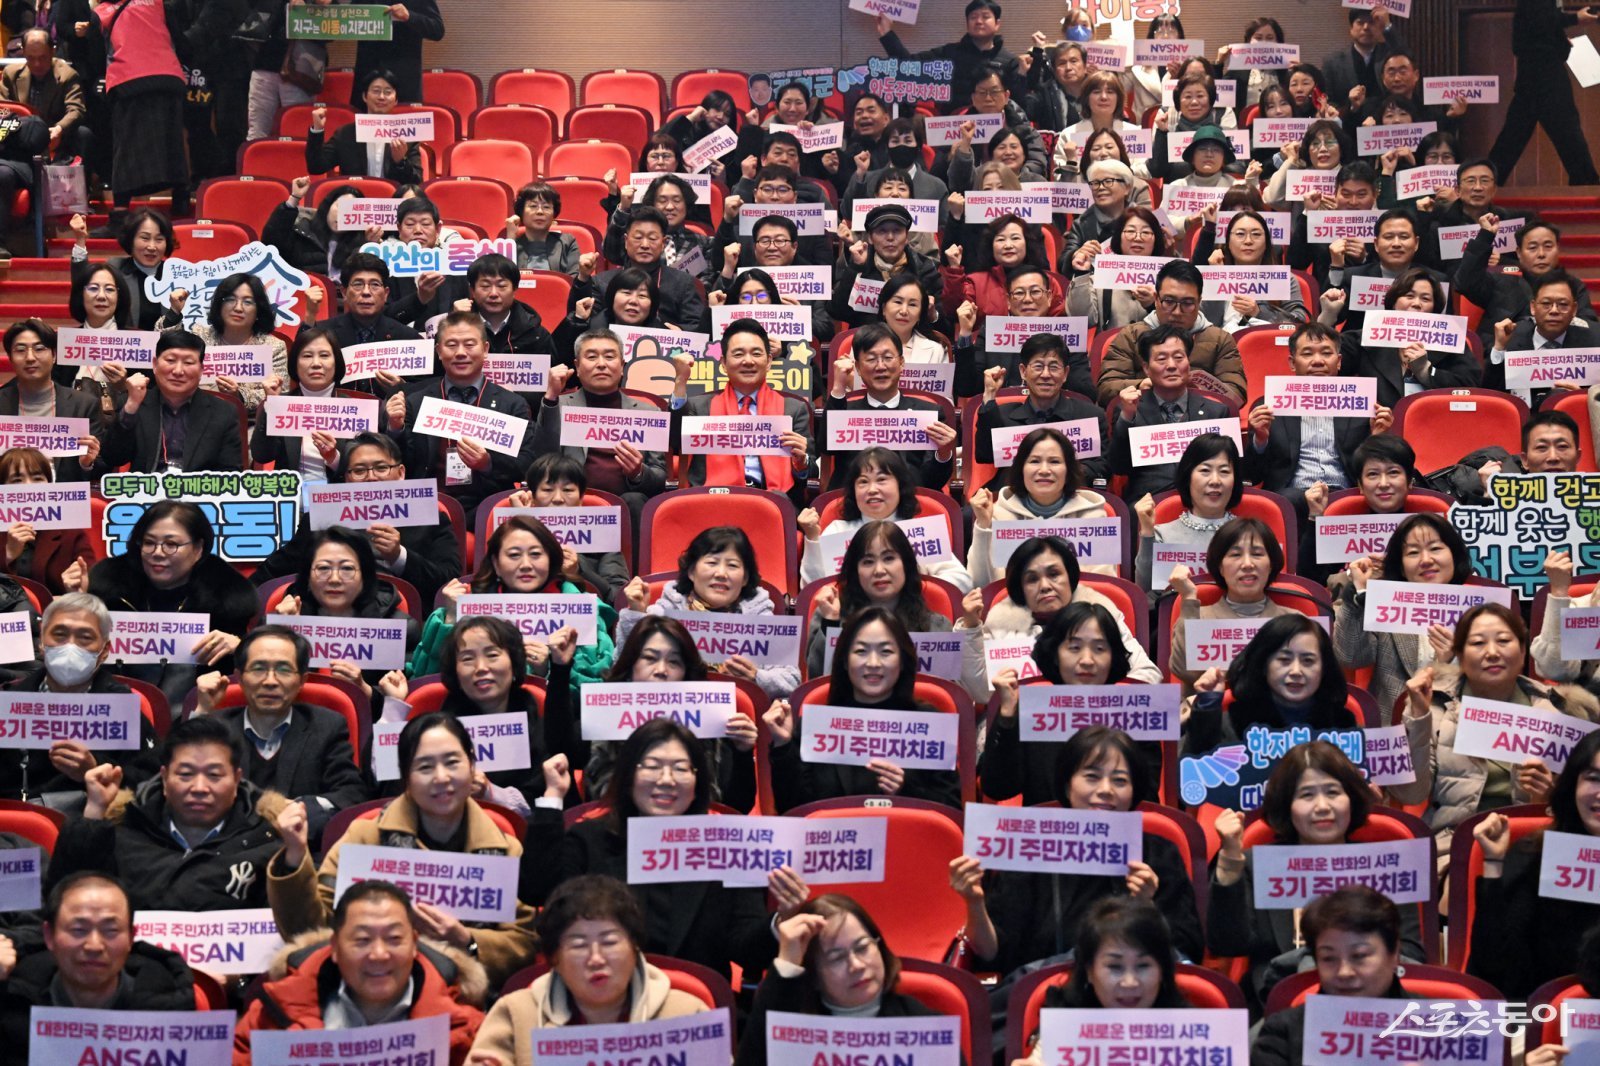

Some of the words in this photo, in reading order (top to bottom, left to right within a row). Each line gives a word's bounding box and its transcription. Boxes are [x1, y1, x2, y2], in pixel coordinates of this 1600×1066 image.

[294, 20, 319, 34] 지구는
[321, 20, 346, 34] 이동이
[348, 20, 384, 34] 지킨다!!
[1245, 56, 1283, 64] ANSAN
[869, 58, 896, 76] 한지붕
[900, 59, 920, 75] 아래
[923, 60, 953, 80] 따뜻한
[870, 78, 950, 102] 와동주민자치회
[374, 128, 416, 138] ANSAN
[1260, 133, 1276, 142] 3기
[1364, 140, 1380, 150] 3기
[1403, 183, 1420, 194] 3기
[344, 214, 360, 226] 3기
[1314, 226, 1332, 238] 3기
[171, 264, 199, 278] 젊음과
[203, 264, 221, 278] 쉼이
[222, 248, 261, 273] 함께하는
[800, 272, 814, 280] 시작
[1229, 272, 1258, 280] 주민자치
[1259, 272, 1288, 280] 국가대표
[1217, 283, 1268, 294] ANSAN
[779, 311, 794, 320] 시작
[1004, 323, 1027, 332] 새로운
[1029, 323, 1052, 332] 변화의
[1054, 323, 1070, 332] 시작
[994, 334, 1016, 346] 3기
[1395, 329, 1458, 346] 주민자치회
[64, 346, 86, 360] 3기
[237, 352, 254, 361] 시작
[376, 348, 399, 357] 변화의
[400, 346, 416, 356] 시작
[366, 356, 426, 372] 주민자치회
[1508, 357, 1540, 366] 대한민국
[1542, 356, 1574, 365] 주민자치
[1531, 367, 1586, 381] ANSAN
[1285, 384, 1311, 393] 새로운
[1312, 384, 1338, 394] 변화의
[1340, 384, 1356, 394] 시작
[1273, 395, 1296, 410] 3기
[1301, 395, 1368, 411] 주민자치회
[564, 414, 598, 424] 대한민국
[600, 415, 632, 426] 주민자치
[729, 422, 754, 432] 변화의
[756, 422, 772, 432] 시작
[874, 418, 899, 427] 변화의
[900, 418, 918, 427] 시작
[25, 424, 50, 433] 변화의
[52, 424, 70, 434] 시작
[586, 428, 644, 443] ANSAN
[1150, 431, 1176, 441] 새로운
[690, 434, 714, 448] 3기
[836, 430, 860, 444] 3기
[1140, 444, 1164, 459] 3기
[104, 474, 158, 496] 모두가
[164, 474, 238, 496] 함께해서
[243, 474, 298, 496] 행복한
[7, 492, 46, 502] 주민자치
[48, 490, 87, 502] 국가대표
[313, 492, 351, 504] 대한민국
[353, 490, 393, 501] 주민자치
[394, 487, 434, 498] 국가대표
[1492, 477, 1546, 510] 함께
[340, 503, 409, 522] ANSAN
[579, 514, 618, 526] 국가대표
[1453, 508, 1507, 541] 함께
[1516, 506, 1570, 543] 웃는
[907, 527, 925, 538] 시작
[996, 530, 1035, 540] 대한민국
[1079, 526, 1118, 538] 국가대표
[1320, 524, 1358, 536] 대한민국
[1156, 551, 1196, 562] 대한민국
[1393, 591, 1425, 603] 새로운
[461, 604, 503, 616] 대한민국
[506, 604, 548, 614] 주민자치
[551, 602, 593, 614] 국가대표
[1376, 606, 1406, 626] 3기
[116, 621, 159, 634] 주민자치
[162, 622, 205, 635] 국가대표
[316, 625, 358, 638] 주민자치
[360, 626, 402, 640] 국가대표
[713, 622, 755, 636] 주민자치
[758, 624, 798, 636] 국가대표
[1212, 628, 1243, 640] 새로운
[920, 641, 960, 653] 국가대표
[1197, 644, 1227, 662] 3기
[586, 693, 632, 706] 대한민국
[636, 692, 682, 706] 주민자치
[685, 692, 732, 705] 국가대표
[1049, 695, 1084, 708] 새로운
[1088, 694, 1124, 708] 변화의
[1126, 694, 1151, 708] 시작
[10, 702, 46, 715] 새로운
[48, 703, 83, 716] 변화의
[86, 703, 110, 717] 시작
[830, 718, 864, 732] 새로운
[866, 720, 902, 734] 변화의
[905, 722, 929, 736] 시작
[1032, 713, 1066, 732] 3기
[1464, 706, 1512, 728] 대한민국
[1515, 714, 1562, 737] 주민자치
[31, 720, 128, 741] 주민자치회
[478, 722, 524, 738] 국가대표
[812, 733, 845, 755] 3기
[849, 734, 945, 760] 주민자치회
[996, 818, 1036, 833] 새로운
[1040, 820, 1080, 836] 변화의
[1084, 822, 1110, 837] 시작
[661, 828, 700, 842] 새로운
[704, 828, 744, 842] 변화의
[746, 828, 773, 844] 시작
[834, 830, 858, 844] 시작
[976, 836, 1015, 860] 3기
[1020, 837, 1129, 864] 주민자치회
[641, 850, 678, 871] 3기
[1287, 856, 1328, 871] 새로운
[1331, 855, 1371, 870] 변화의
[1374, 853, 1400, 868] 시작
[370, 858, 411, 876] 새로운
[414, 862, 453, 880] 변화의
[456, 865, 484, 882] 시작
[1554, 864, 1594, 890] 3기
[1268, 877, 1307, 898] 3기
[170, 922, 224, 937] 주민자치
[1342, 1012, 1388, 1028] 새로운
[36, 1020, 98, 1039] 대한민국
[102, 1025, 164, 1042] 주민자치
[168, 1025, 228, 1042] 국가대표
[772, 1025, 828, 1045] 대한민국
[831, 1030, 890, 1047] 주민자치
[894, 1030, 954, 1046] 국가대표
[1078, 1024, 1124, 1040] 새로운
[1128, 1024, 1175, 1040] 변화의
[1178, 1023, 1210, 1040] 시작
[538, 1040, 598, 1056] 대한민국
[602, 1032, 663, 1052] 주민자치
[666, 1022, 725, 1046] 국가대표
[1320, 1031, 1363, 1056] 3기
[289, 1041, 334, 1059] 새로운
[338, 1038, 384, 1056] 변화의
[386, 1034, 416, 1051] 시작
